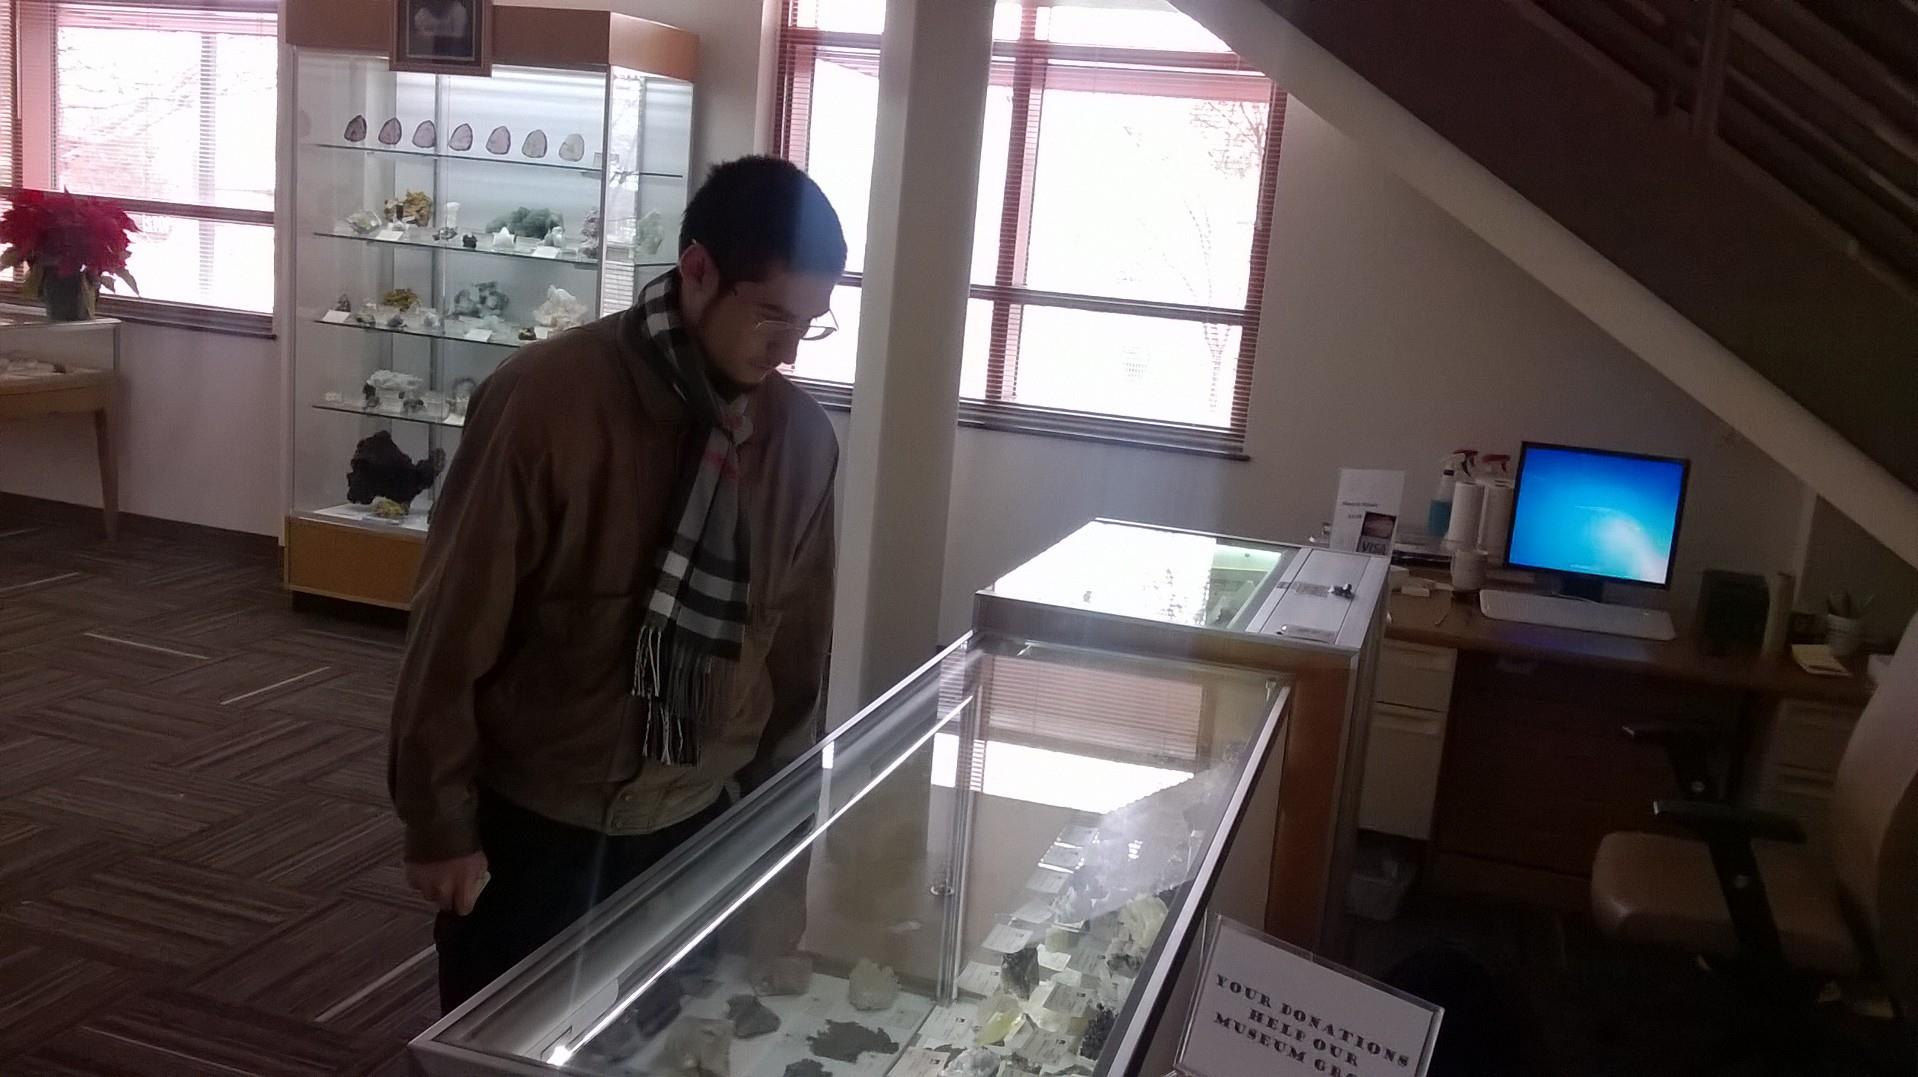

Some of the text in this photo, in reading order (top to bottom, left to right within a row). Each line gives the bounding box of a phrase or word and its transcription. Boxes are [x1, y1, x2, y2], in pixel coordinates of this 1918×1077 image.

[1213, 1011, 1306, 1064] MUSEUM
[1216, 974, 1409, 1067] YOUR DONATIONS
[1248, 1008, 1358, 1067] HELP OUR
